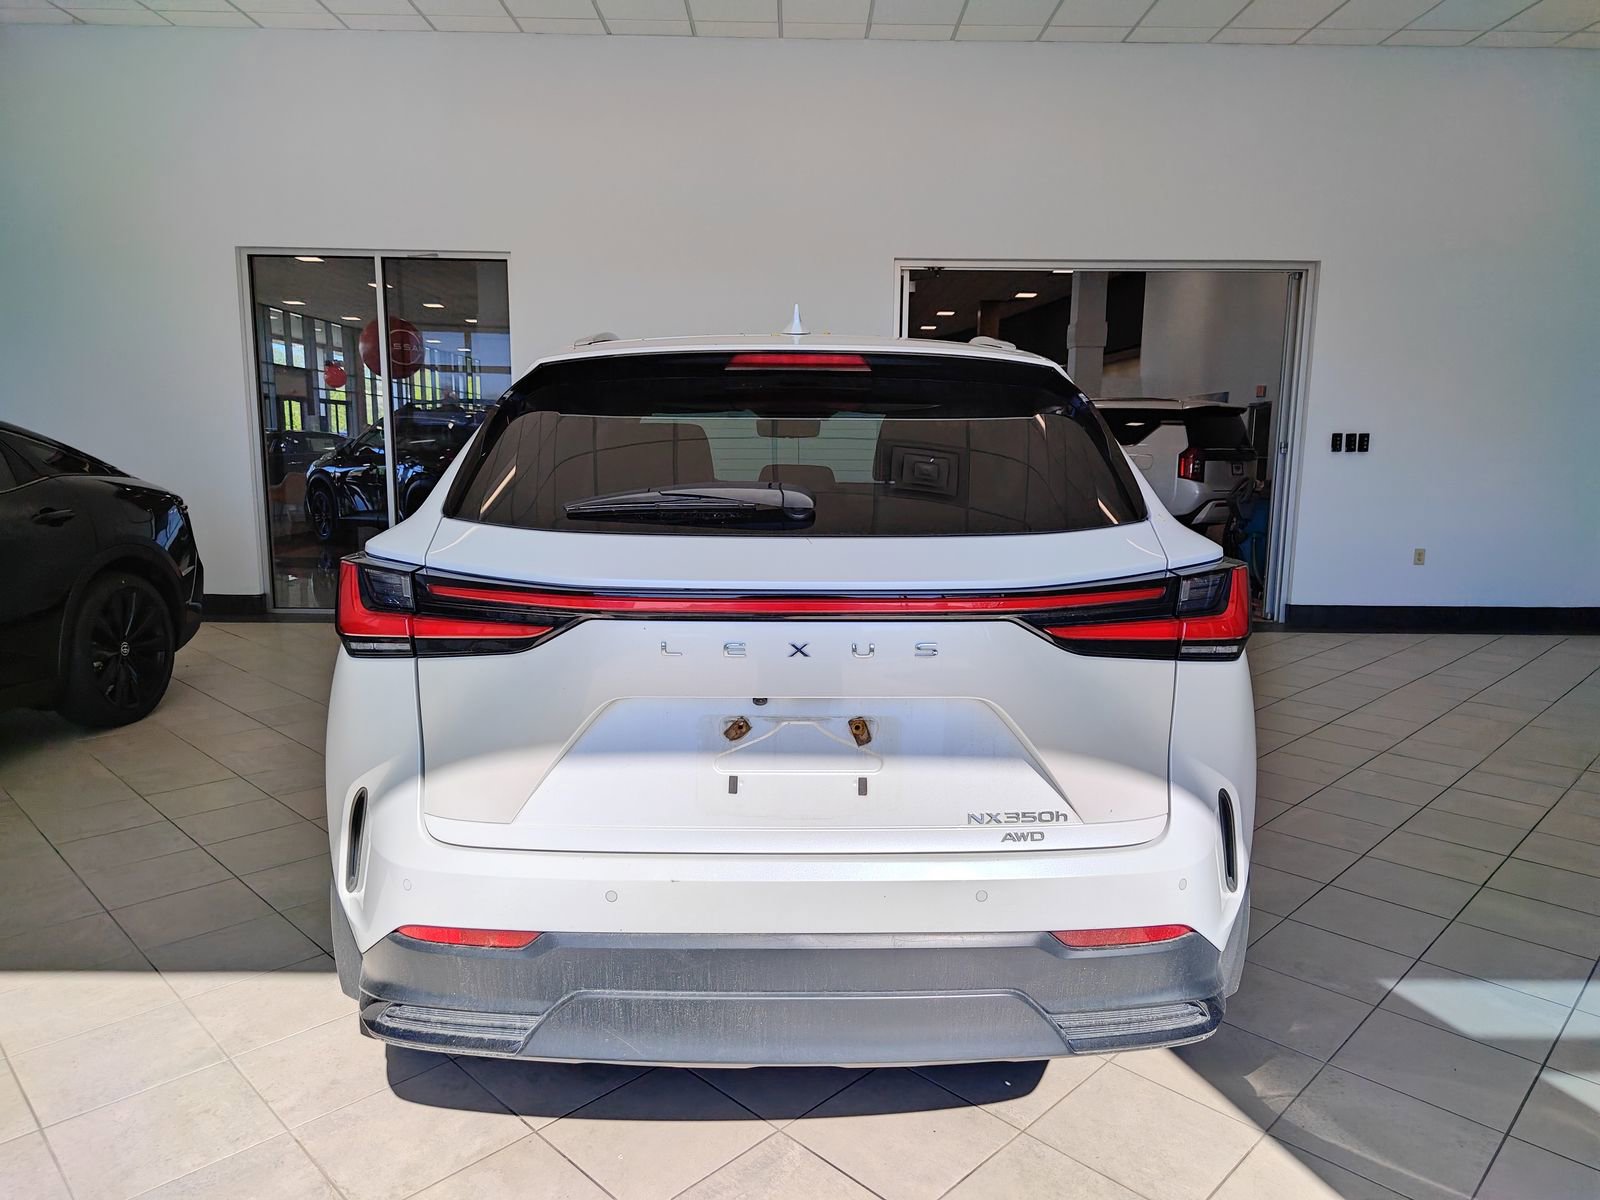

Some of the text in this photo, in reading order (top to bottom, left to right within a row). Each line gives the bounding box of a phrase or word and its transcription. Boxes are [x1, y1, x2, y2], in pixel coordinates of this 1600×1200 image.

[660, 641, 939, 658] LEXUS
[967, 810, 1069, 825] NX350h
[1000, 831, 1045, 843] AWD
